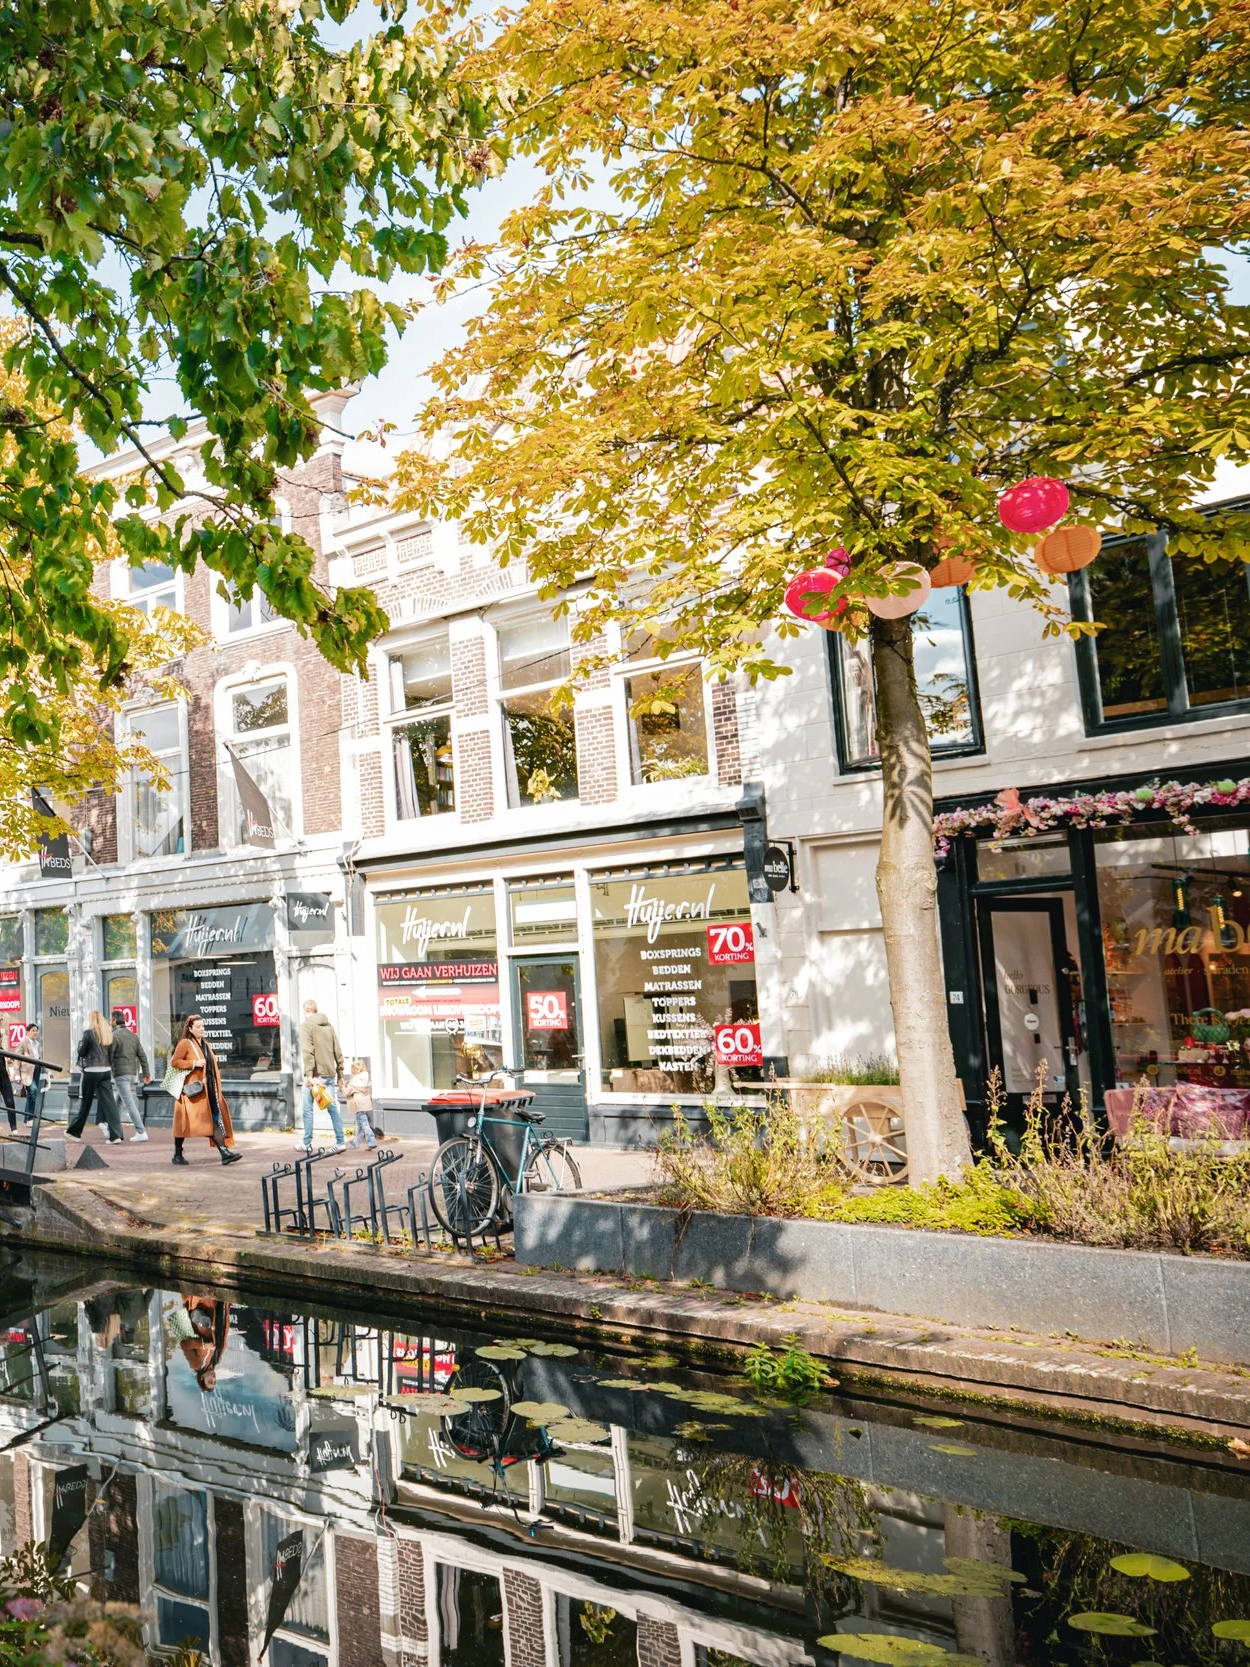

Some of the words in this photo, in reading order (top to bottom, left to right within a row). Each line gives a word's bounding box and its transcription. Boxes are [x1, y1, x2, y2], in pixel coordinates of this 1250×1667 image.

[709, 926, 754, 953] 70%
[1134, 925, 1202, 956] ma
[640, 948, 702, 960] BOXSPRINGS
[714, 952, 750, 962] KORTING
[193, 968, 232, 978] BOXSPRINGS
[380, 967, 400, 979] WIJ
[402, 966, 432, 979] GAAN
[434, 963, 498, 977] VERHUIZEN
[652, 964, 692, 975] BEDDEN
[1164, 967, 1193, 976] atelier
[200, 981, 225, 989] BEDDEN
[644, 980, 702, 992] MATRASSEN
[195, 993, 231, 1002] MATRASSEN
[386, 998, 410, 1006] TOTALE
[652, 996, 697, 1007] TOPPERS
[199, 1005, 227, 1013] TOPPERS
[529, 995, 567, 1019] 50%
[533, 1019, 562, 1027] KORTING
[652, 1013, 697, 1024] KUSSENS
[717, 1027, 762, 1054] 60%
[648, 1045, 709, 1056] DEKBEDDEN
[721, 1054, 757, 1063] KORTING
[659, 1061, 699, 1072] KASTEN
